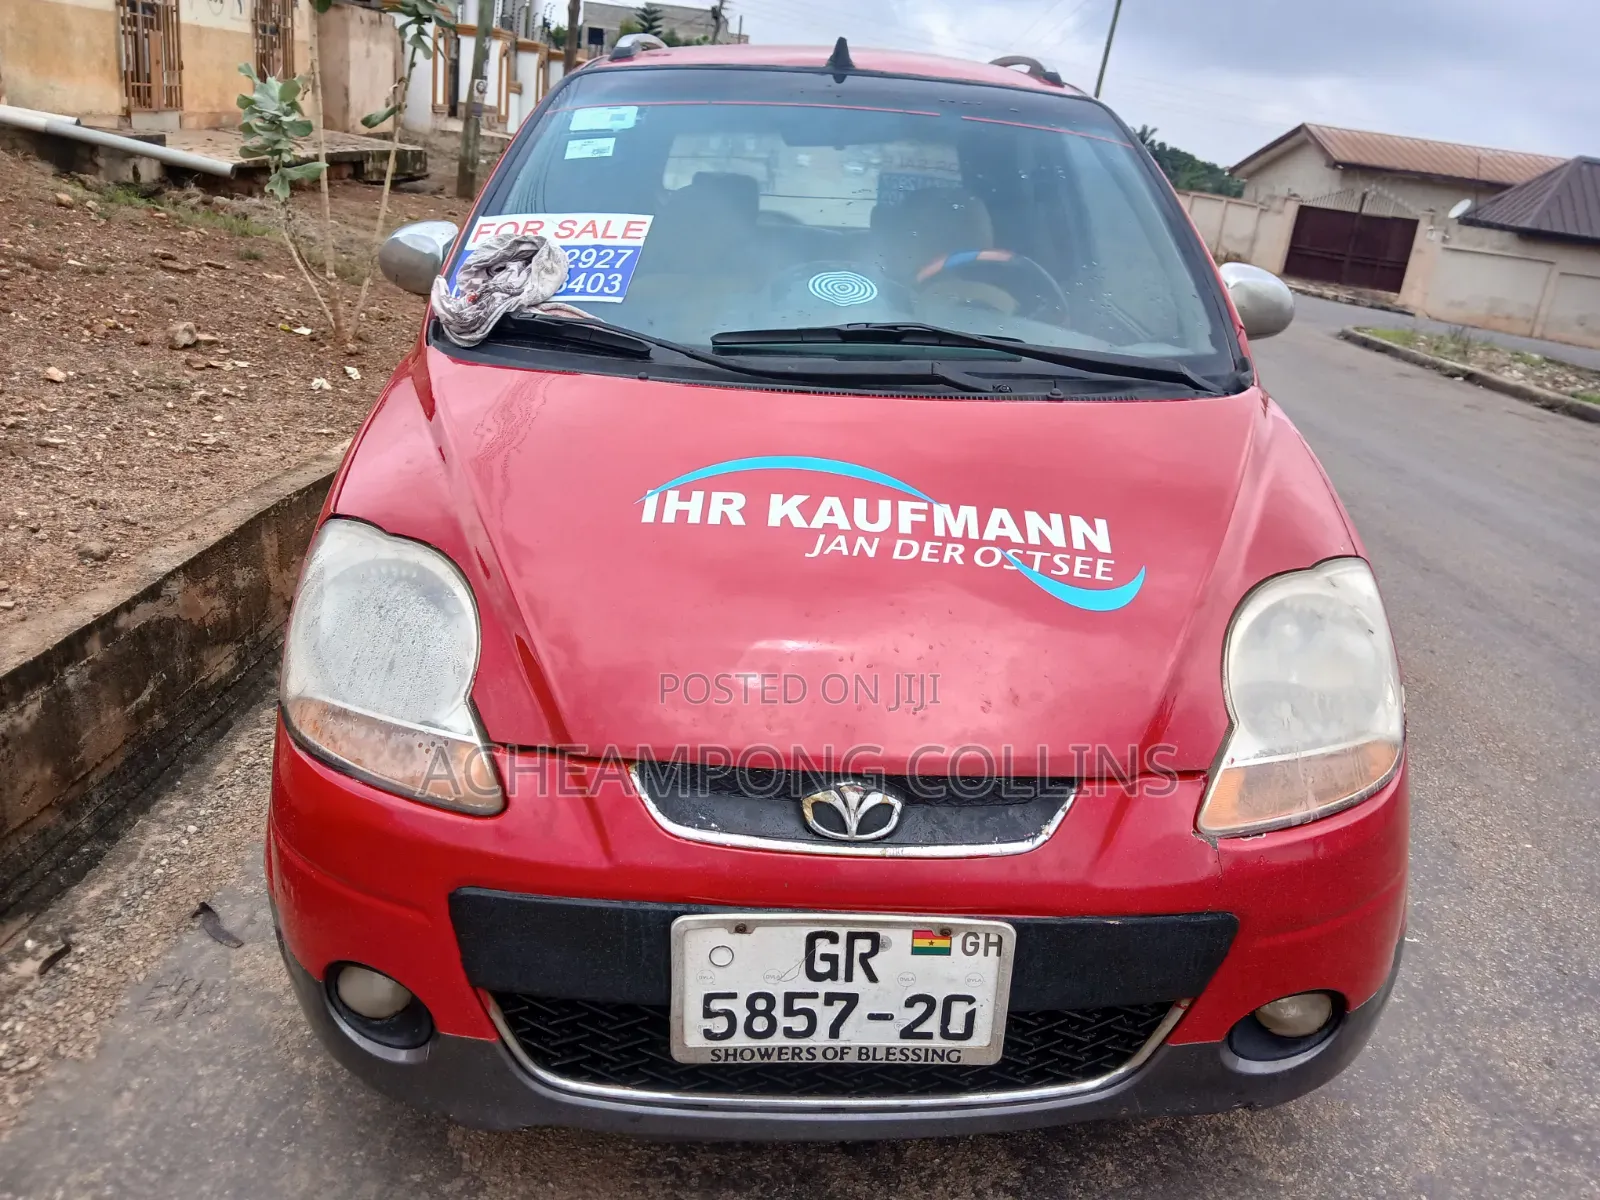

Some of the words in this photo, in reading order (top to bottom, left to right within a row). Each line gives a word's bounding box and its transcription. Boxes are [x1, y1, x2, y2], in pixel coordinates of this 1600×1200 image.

[472, 220, 545, 243] FOR
[554, 219, 647, 239] SALE
[641, 489, 747, 526] IHR
[767, 493, 1112, 554] KAUFMANN
[805, 533, 879, 558] JAN
[892, 539, 965, 565] DER
[973, 546, 1115, 581] OSTSEE
[805, 930, 880, 983] GR
[961, 931, 1003, 957] GH
[702, 991, 977, 1041] 5857-20
[710, 1046, 817, 1062] SHOWERS
[821, 1046, 853, 1061] OF
[857, 1046, 962, 1063] BLESSING
